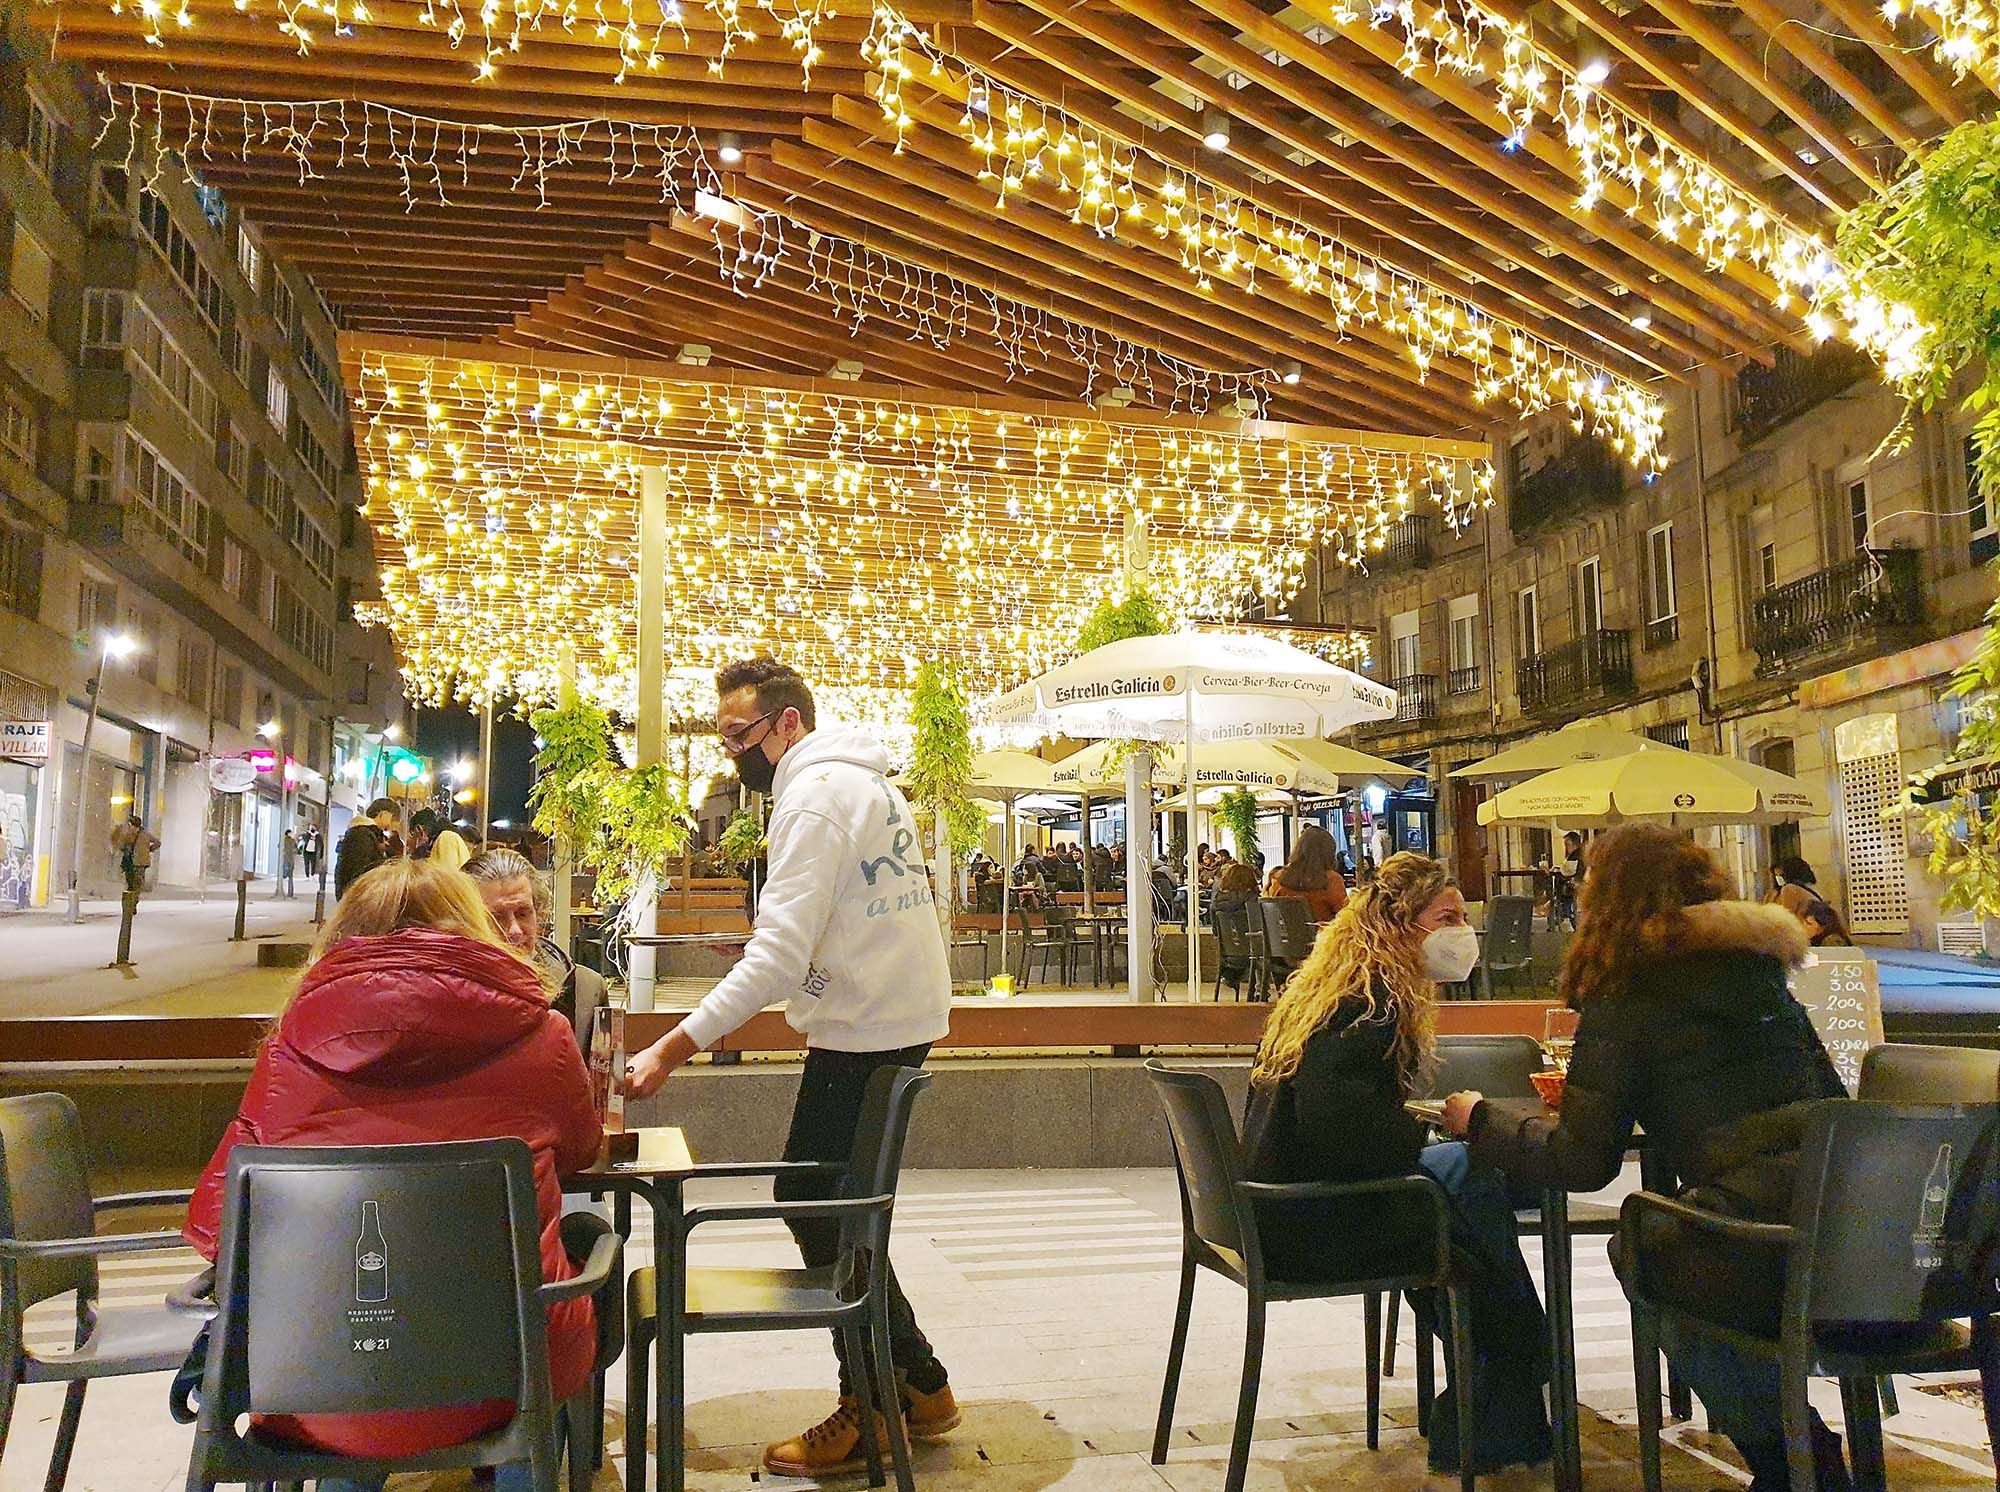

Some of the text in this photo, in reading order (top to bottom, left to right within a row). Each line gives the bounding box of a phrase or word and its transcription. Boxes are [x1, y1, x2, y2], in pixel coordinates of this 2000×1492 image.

[1055, 676, 1160, 702] Estrella Galicia
[0, 724, 46, 736] RAJE
[2, 741, 46, 753] VILLAR
[1196, 769, 1273, 785] Estrella Galicia
[866, 895, 890, 918] a
[1832, 1040, 1869, 1052] SIDRA
